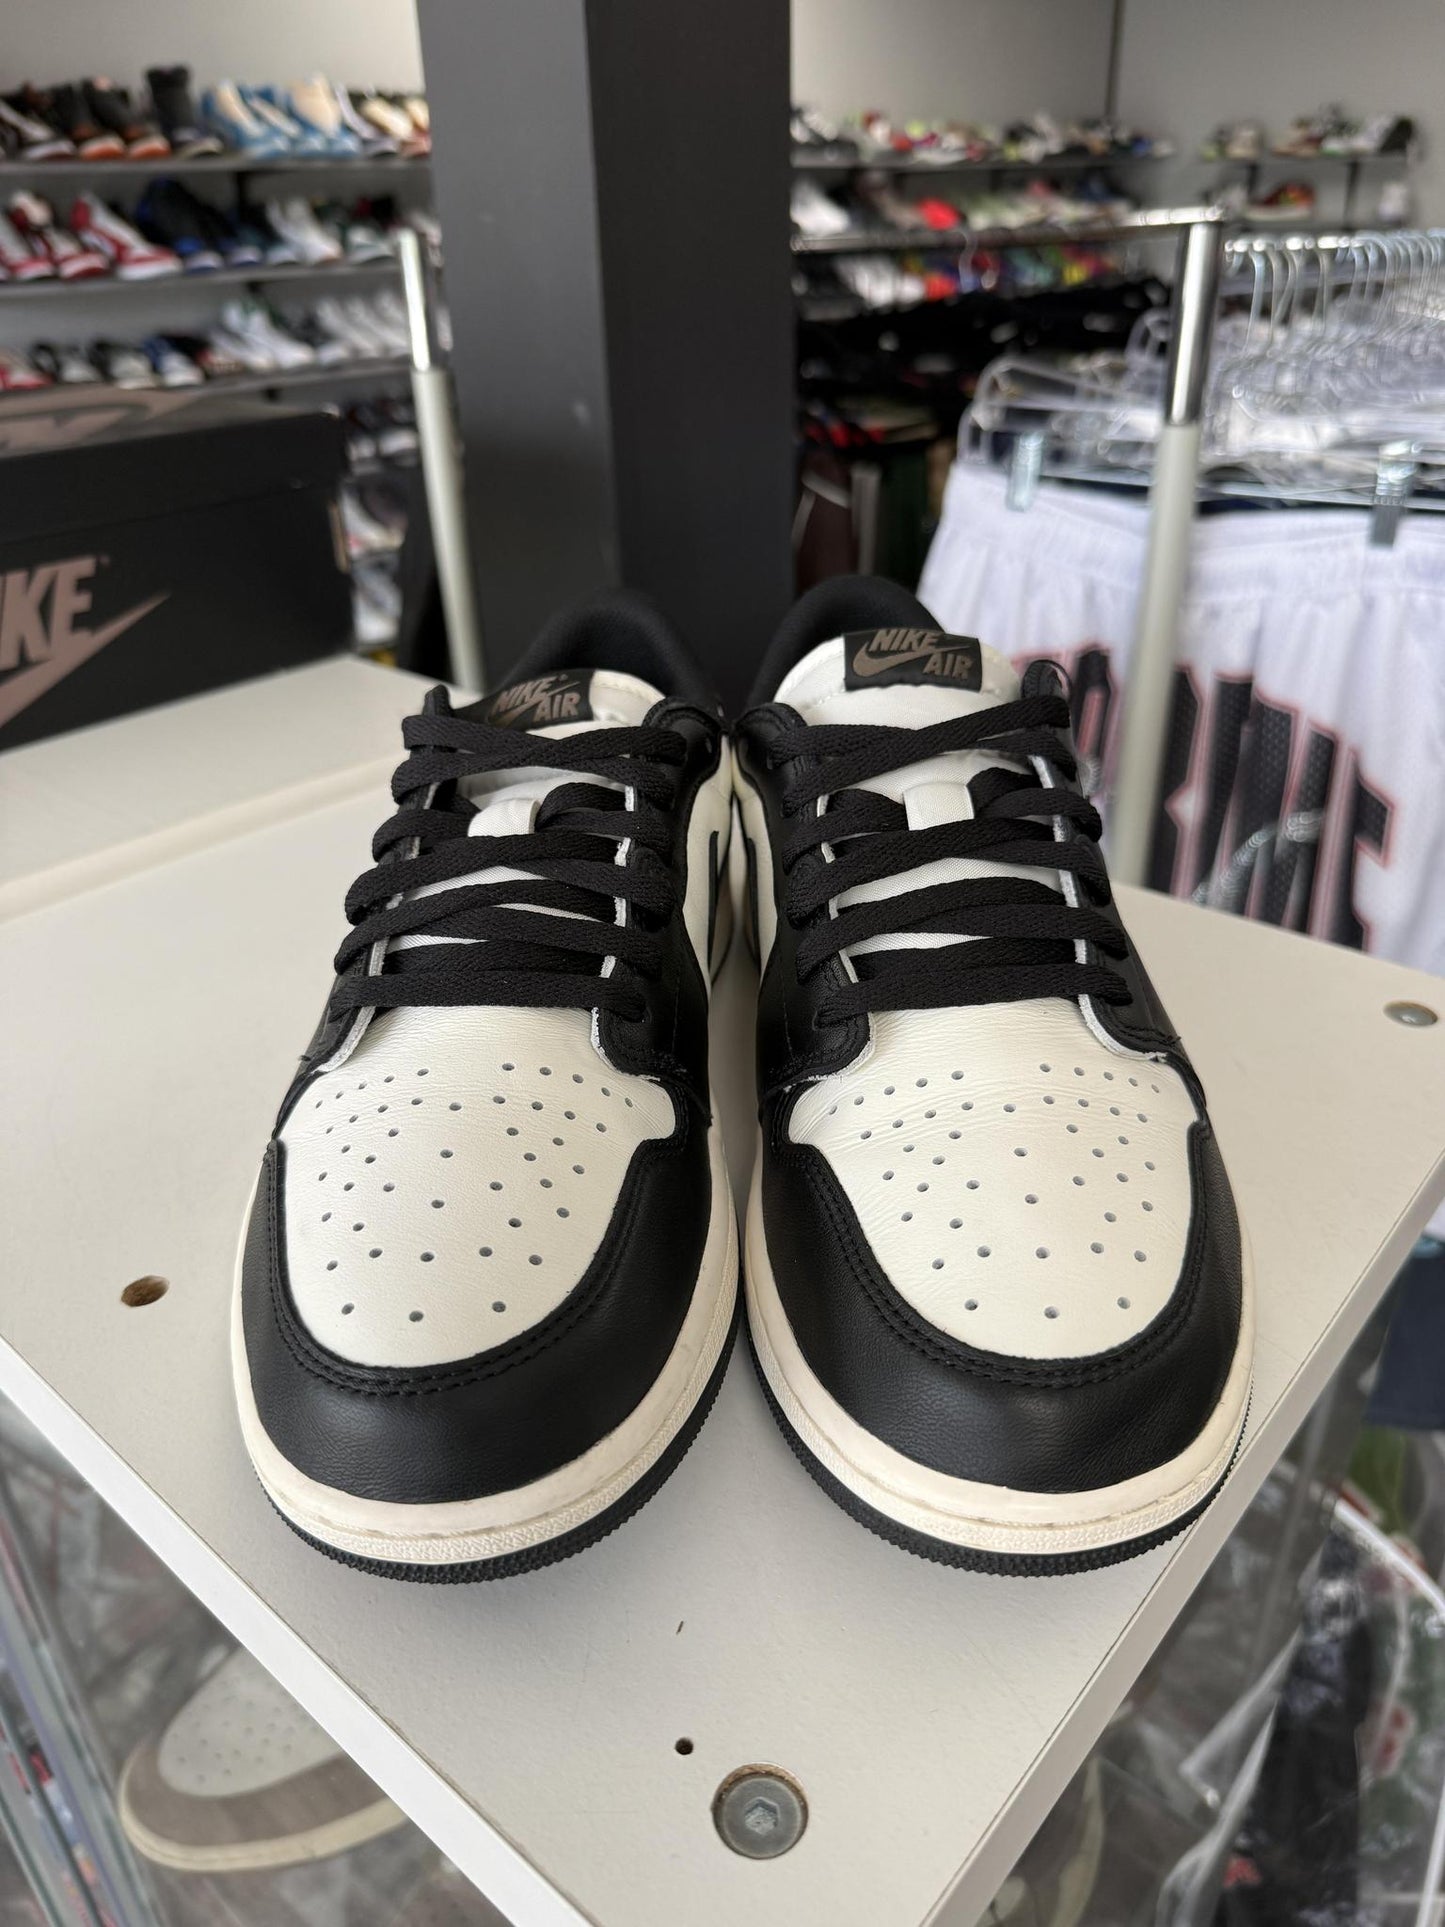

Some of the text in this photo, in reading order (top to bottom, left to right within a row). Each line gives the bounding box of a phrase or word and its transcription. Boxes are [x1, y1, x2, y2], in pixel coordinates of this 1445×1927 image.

[0, 556, 97, 670] KE
[869, 628, 940, 652] NIKE
[922, 652, 973, 679] AIR
[491, 676, 558, 714] NIKE
[533, 692, 580, 722] AIR
